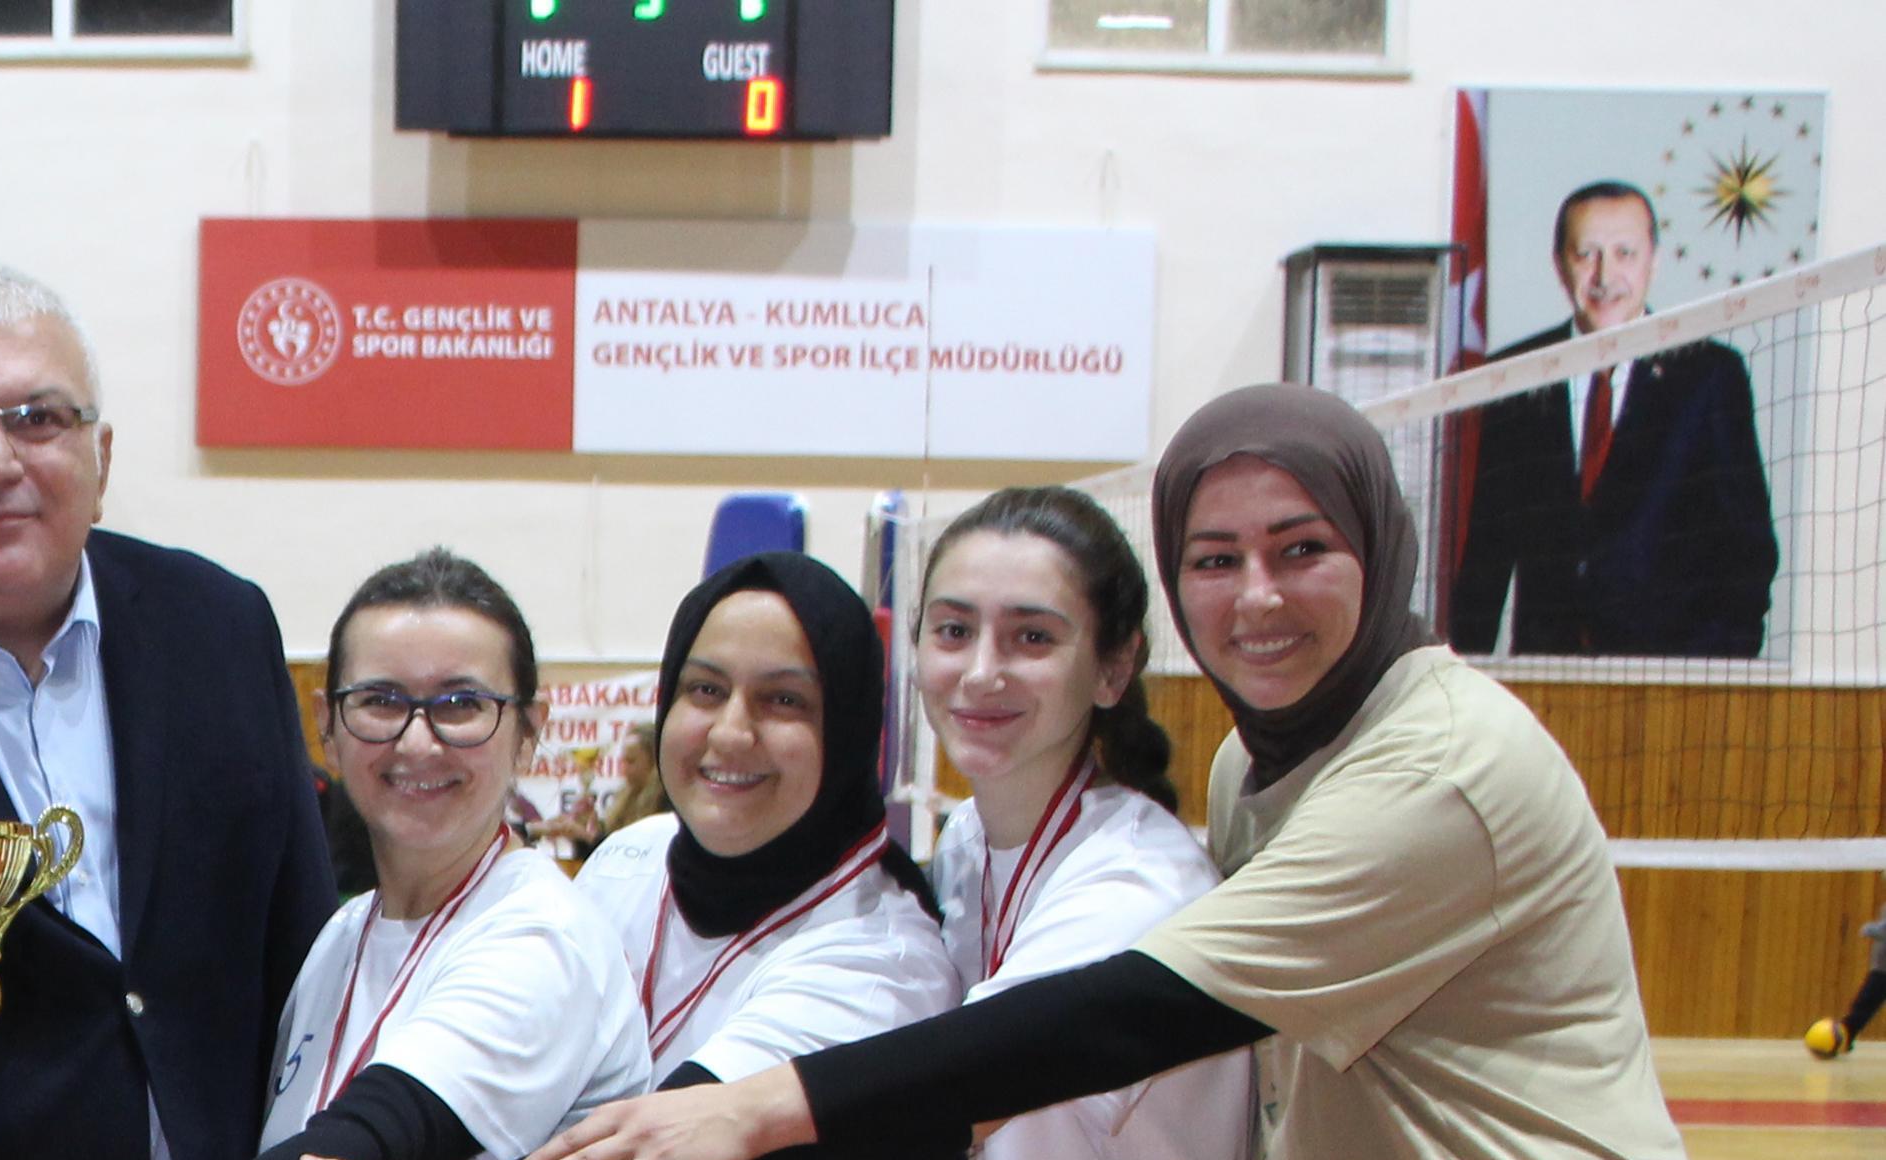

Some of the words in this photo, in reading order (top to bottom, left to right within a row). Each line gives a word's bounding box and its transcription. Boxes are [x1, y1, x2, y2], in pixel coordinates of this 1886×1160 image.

[520, 39, 588, 78] HOME
[702, 42, 770, 80] GUEST
[569, 77, 592, 130] 1
[745, 77, 781, 133] 0
[352, 305, 398, 329] T.C.
[403, 302, 513, 333] GENÇLİK
[519, 306, 552, 331] VE
[592, 299, 737, 327] ANTALYA
[764, 301, 926, 329] KUMLUCA
[352, 333, 418, 358] SPOR
[422, 331, 554, 359] BAKANLIĞI
[592, 339, 718, 374] GENÇLİK
[727, 343, 763, 368] VE
[773, 344, 850, 370] SPOR
[859, 340, 919, 376] İLÇE
[928, 341, 1123, 374] MÜDÜRLÜĞÜ
[273, 1033, 314, 1096] 5
